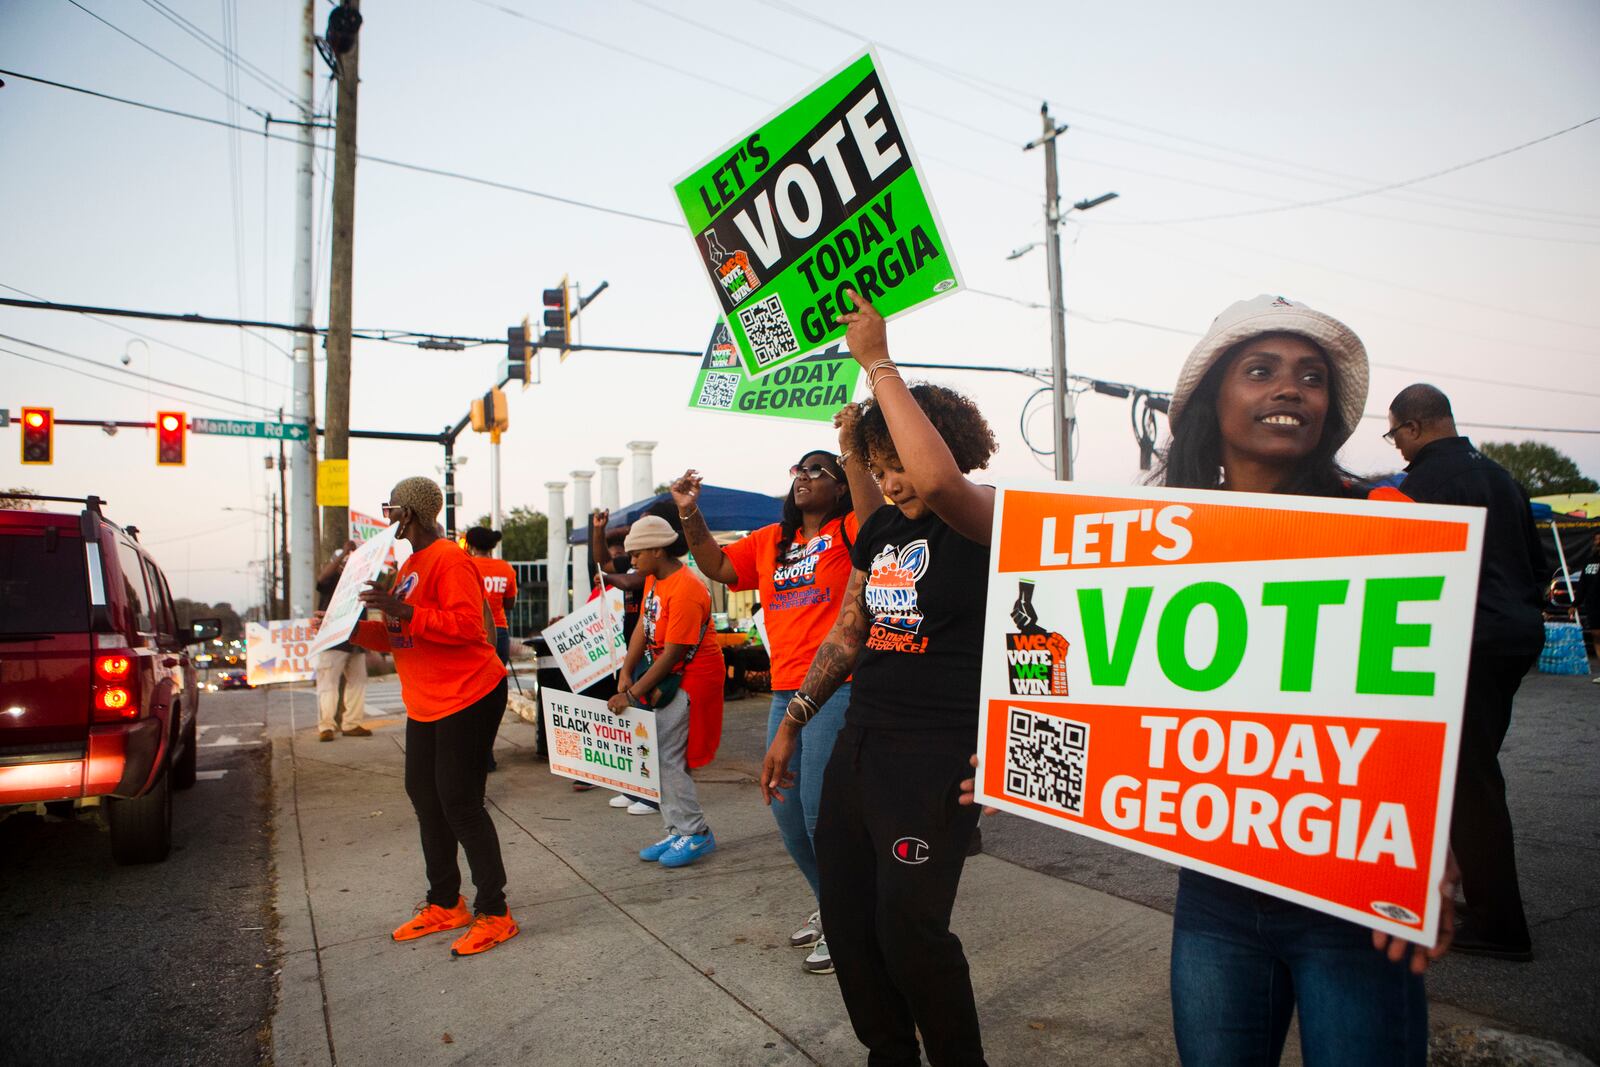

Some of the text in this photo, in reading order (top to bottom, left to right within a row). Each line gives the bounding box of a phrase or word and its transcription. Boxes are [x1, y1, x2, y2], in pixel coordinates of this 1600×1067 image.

[699, 133, 770, 218] LET'S
[732, 87, 902, 270] VOTE
[796, 191, 898, 294] TODAY
[720, 265, 744, 287] VOTE
[800, 224, 940, 344] GEORGIA
[738, 384, 847, 411] GEORGIA
[196, 420, 284, 437] Manford Rd
[1040, 504, 1193, 567] LET'S
[484, 576, 508, 593] OTE
[553, 631, 567, 643] THE
[569, 611, 599, 634] FUTURE
[1076, 575, 1446, 697] VOTE
[282, 642, 309, 657] TO
[557, 630, 588, 654] BLACK
[583, 633, 605, 650] IS ON
[1013, 634, 1047, 651] we
[279, 658, 314, 672] ALL
[1007, 649, 1052, 666] VOTE
[1015, 664, 1048, 681] we
[1013, 678, 1052, 696] WIN.
[551, 702, 631, 729] THE FUTURE OF
[553, 714, 632, 744] BLACK YOUTH
[583, 736, 633, 757] IS ON THE
[1140, 715, 1381, 786] TODAY
[584, 747, 633, 773] BALLOT
[1100, 774, 1418, 870] GEORGIA
